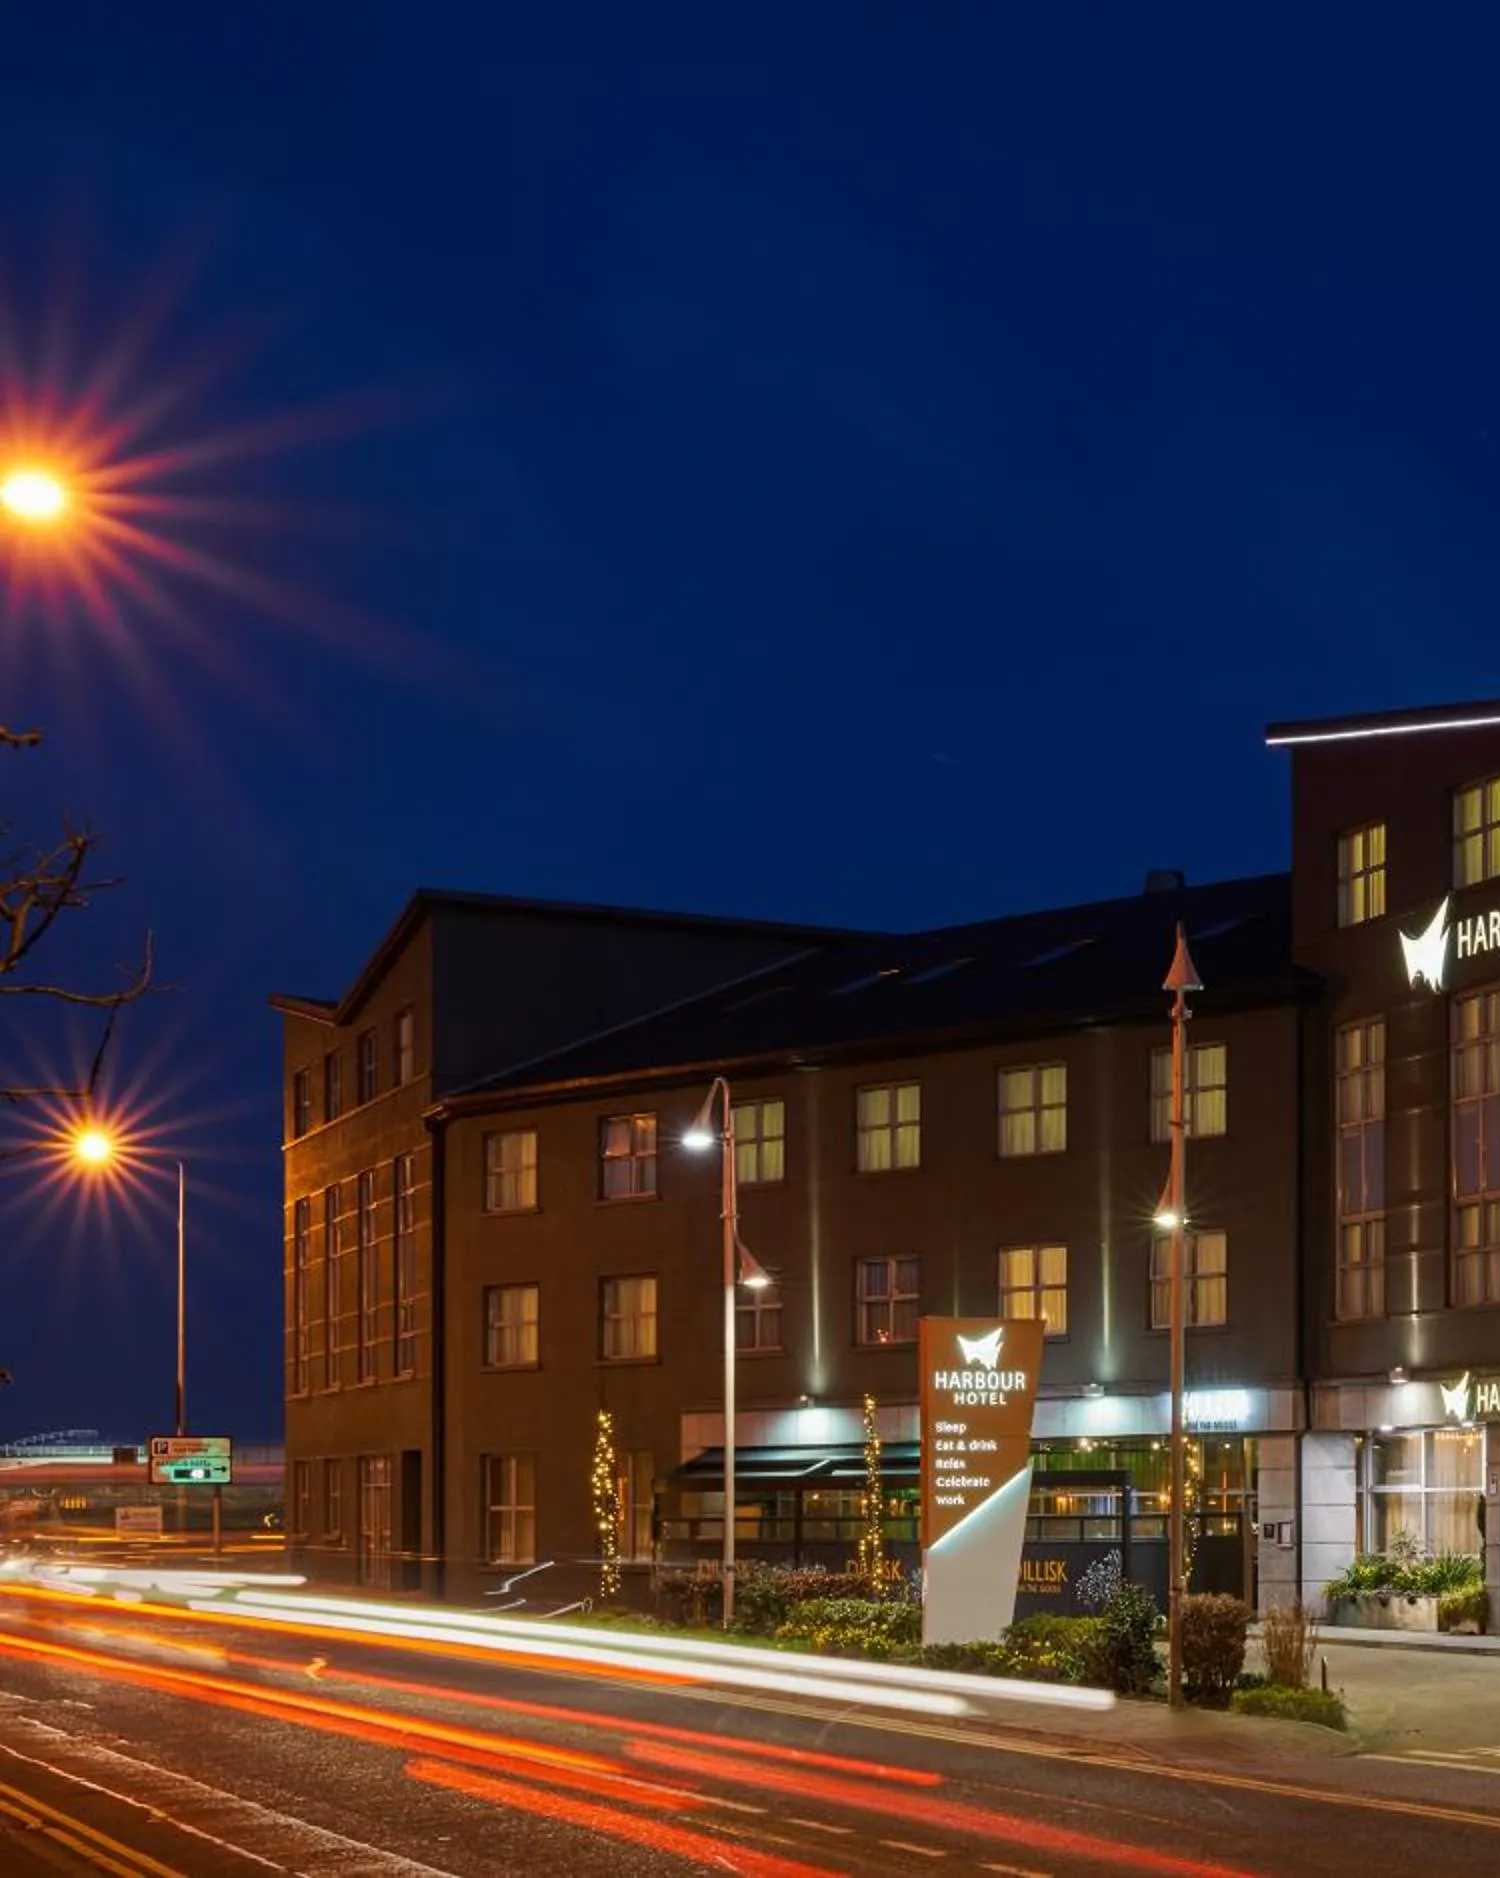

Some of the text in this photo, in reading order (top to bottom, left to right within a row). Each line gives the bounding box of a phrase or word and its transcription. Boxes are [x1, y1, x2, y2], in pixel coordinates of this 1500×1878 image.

[935, 1371, 1025, 1390] HARBOUR
[953, 1391, 1007, 1405] HOTEL
[935, 1421, 967, 1435] Sleep
[935, 1440, 998, 1451] Eat & drink
[935, 1458, 966, 1469] Relax
[935, 1476, 991, 1487] Celebrate
[1019, 1560, 1068, 1582] ILLISK
